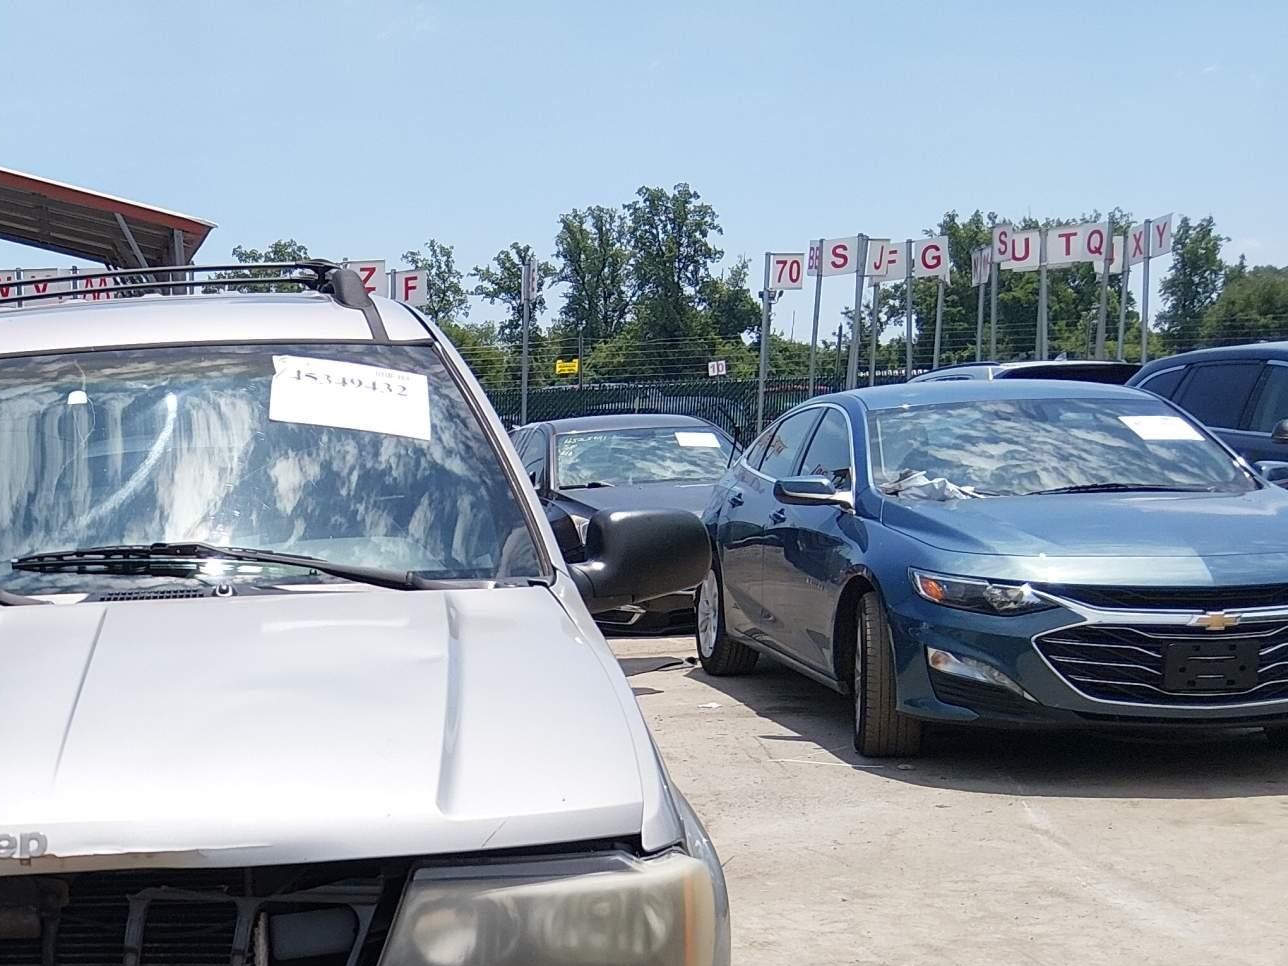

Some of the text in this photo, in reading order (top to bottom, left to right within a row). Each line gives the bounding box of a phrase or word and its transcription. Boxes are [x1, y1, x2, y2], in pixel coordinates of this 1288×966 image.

[998, 230, 1008, 256] S
[1058, 232, 1078, 256] T
[1087, 229, 1103, 256] Q
[1132, 231, 1143, 257] X
[1156, 222, 1168, 248] Y
[831, 244, 849, 269] S
[873, 245, 884, 270] J
[921, 244, 942, 270] G
[1012, 237, 1030, 262] U
[359, 266, 377, 294] Z
[775, 259, 801, 284] 70
[404, 275, 418, 302] F
